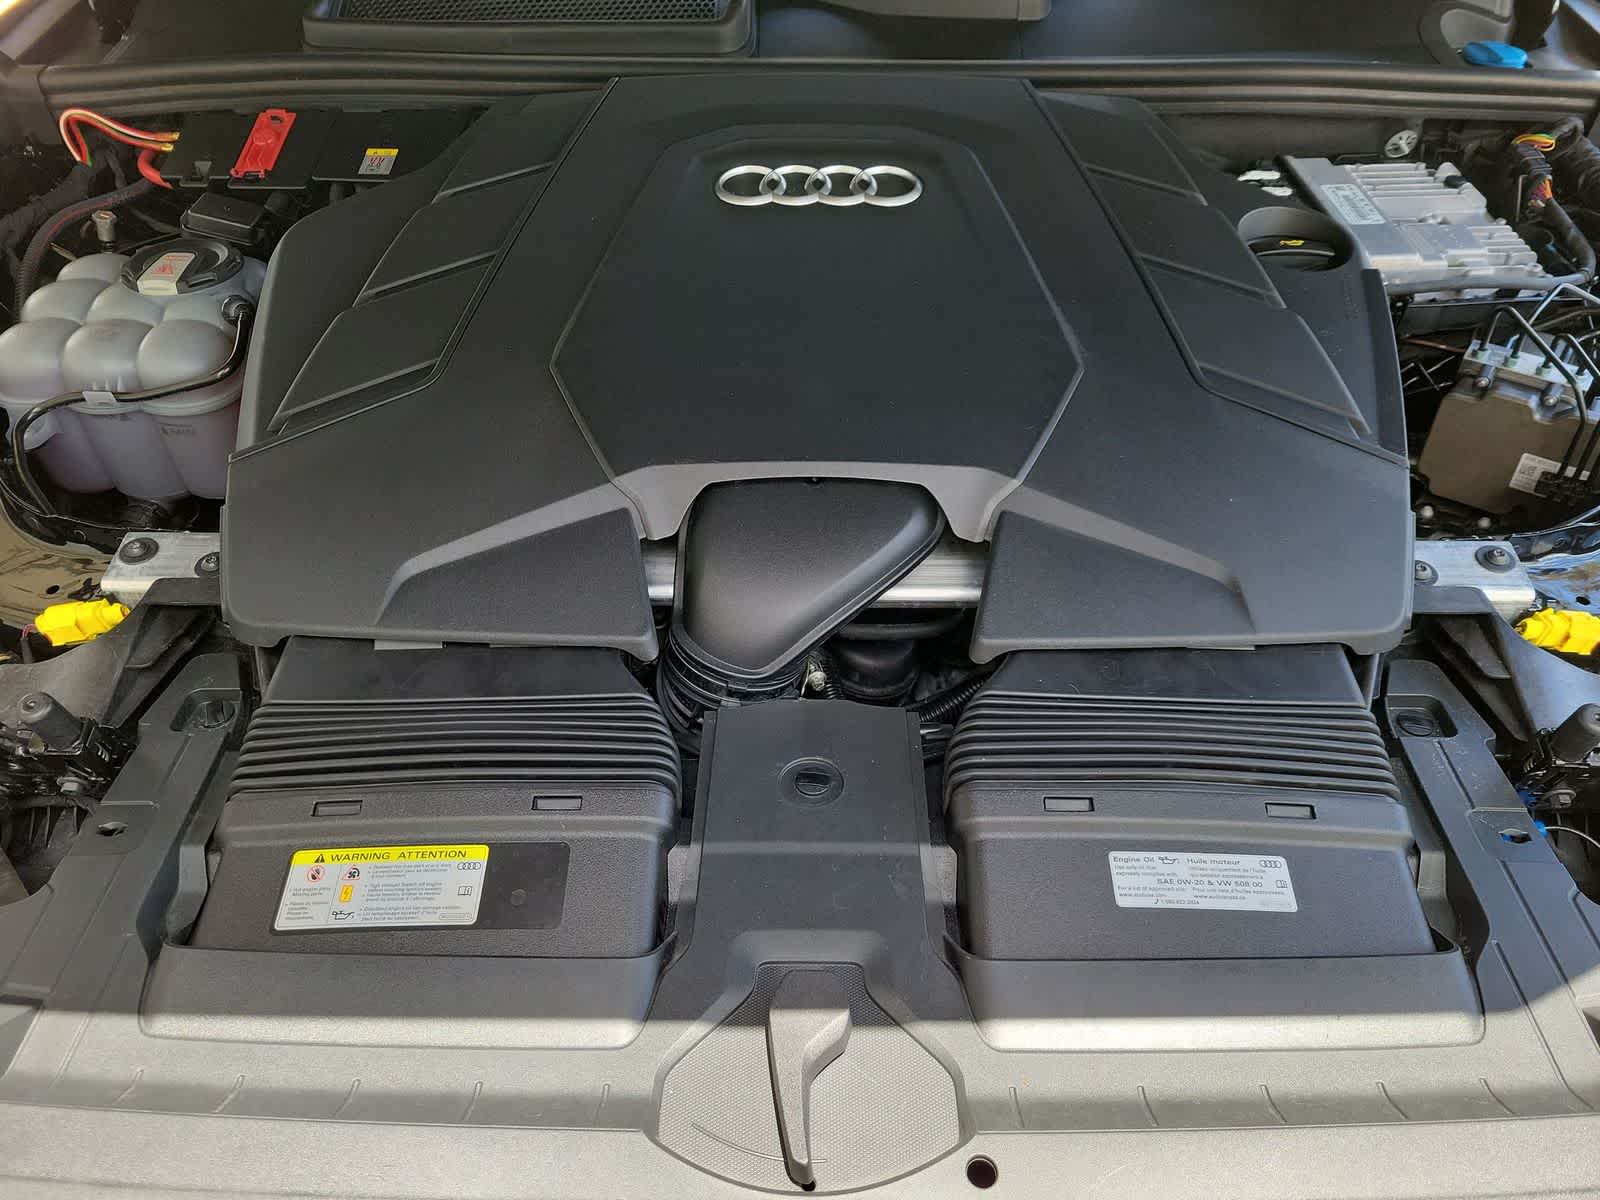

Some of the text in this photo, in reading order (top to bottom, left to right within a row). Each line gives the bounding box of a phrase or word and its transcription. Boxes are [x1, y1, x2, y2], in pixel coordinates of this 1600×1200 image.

[331, 850, 467, 862] WARNING ATTENTION
[1113, 856, 1140, 865] Engine
